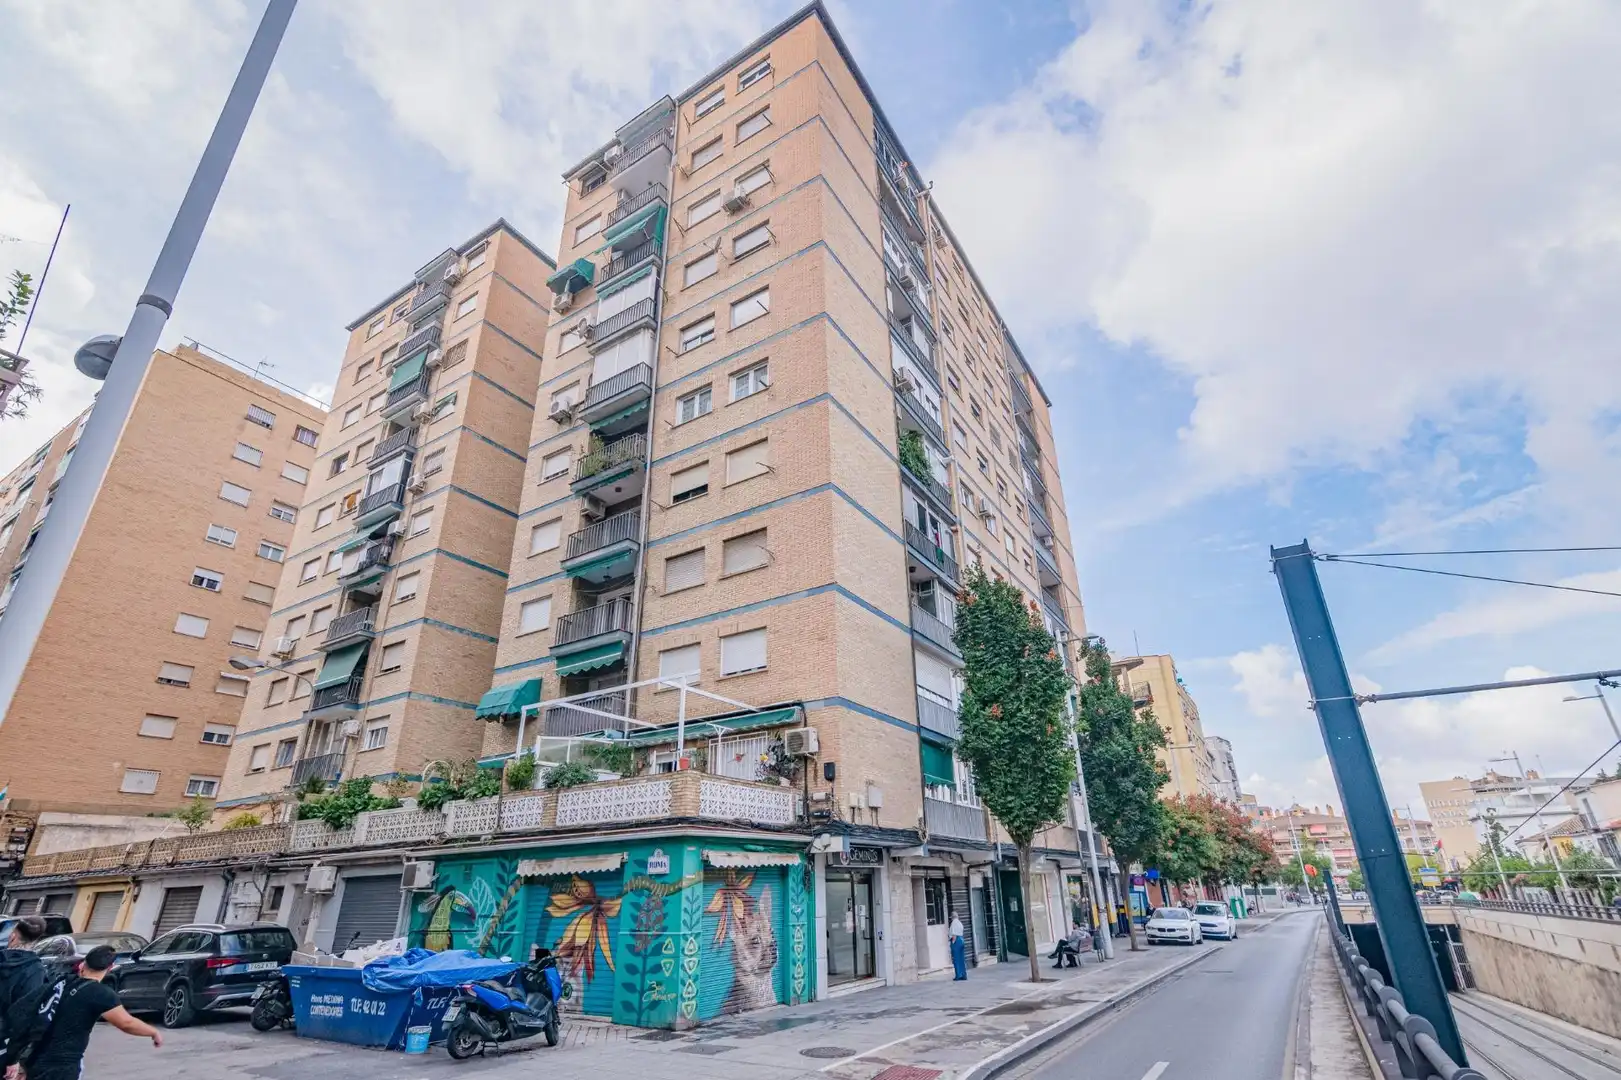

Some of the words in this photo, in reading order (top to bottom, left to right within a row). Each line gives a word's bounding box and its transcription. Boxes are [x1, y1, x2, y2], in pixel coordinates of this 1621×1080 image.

[649, 861, 667, 869] ROMA
[323, 994, 344, 1005] MEDINA
[310, 1005, 344, 1017] CONTENEDORES
[378, 1001, 386, 1016] 22
